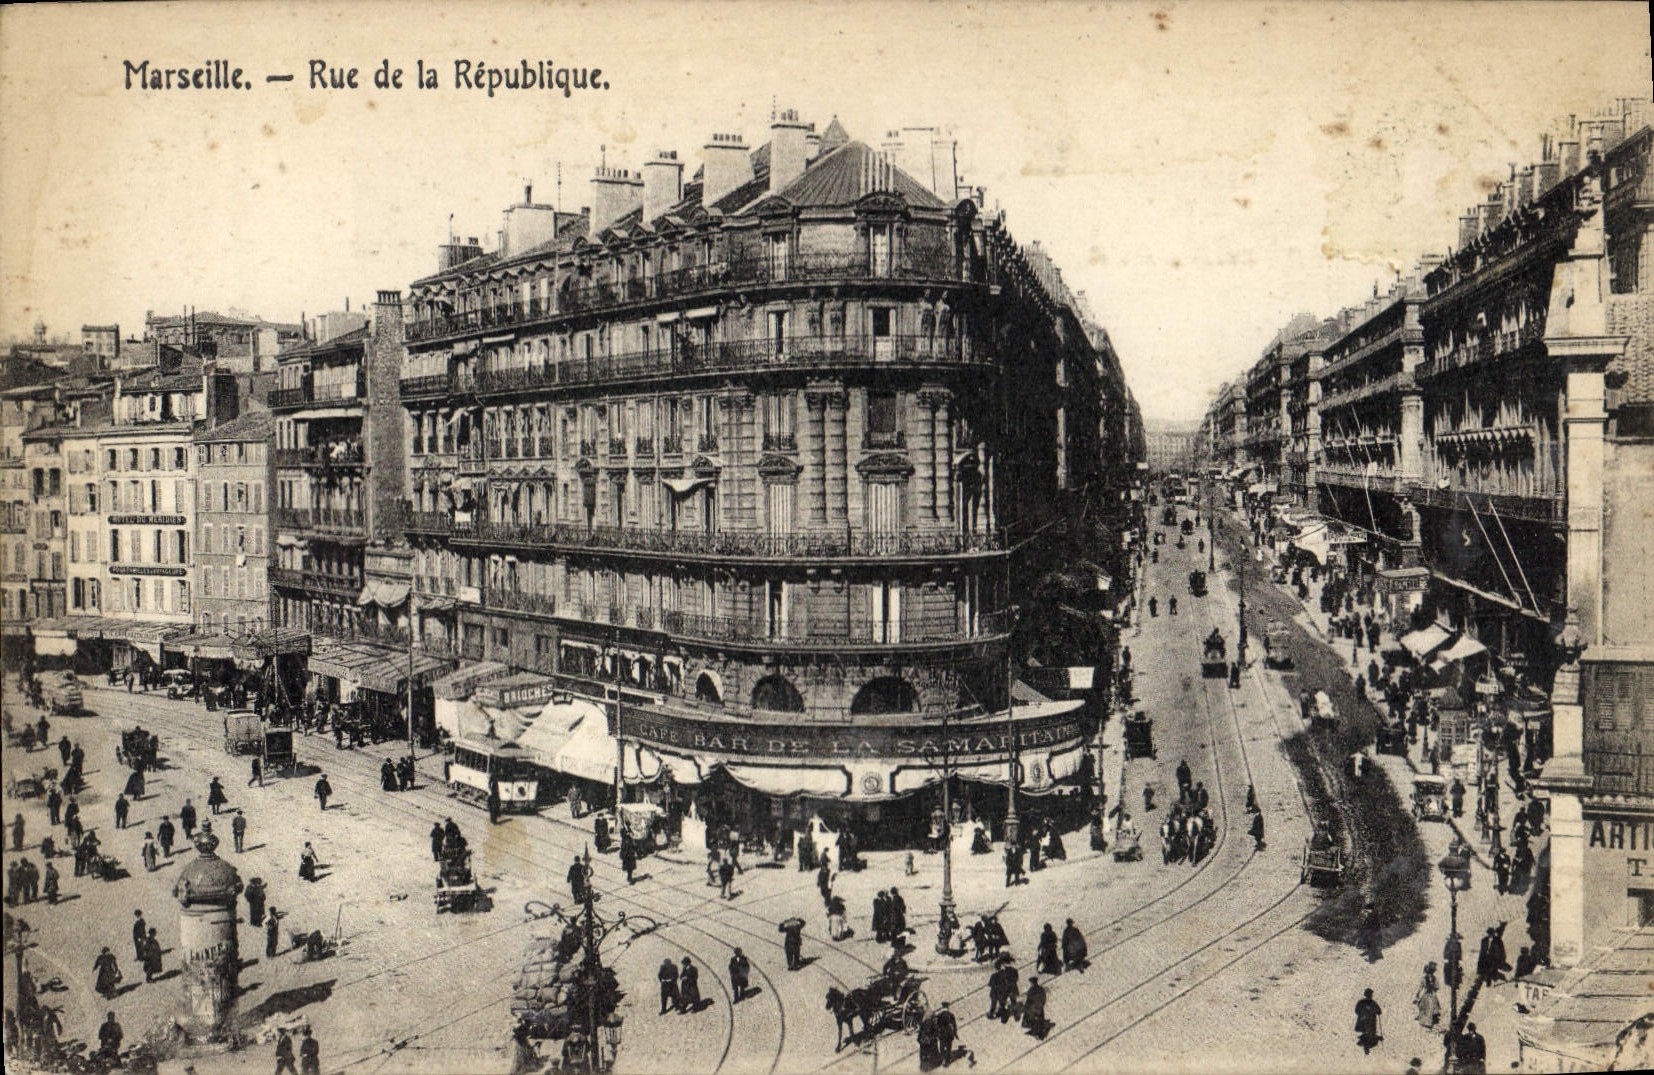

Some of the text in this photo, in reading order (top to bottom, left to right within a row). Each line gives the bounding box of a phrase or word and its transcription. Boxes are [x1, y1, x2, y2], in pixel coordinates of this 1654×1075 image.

[503, 684, 553, 704] BRIOCHES
[694, 734, 749, 752] BAR
[767, 739, 810, 753] DE
[831, 740, 879, 754] LA
[1589, 820, 1654, 851] ARTI
